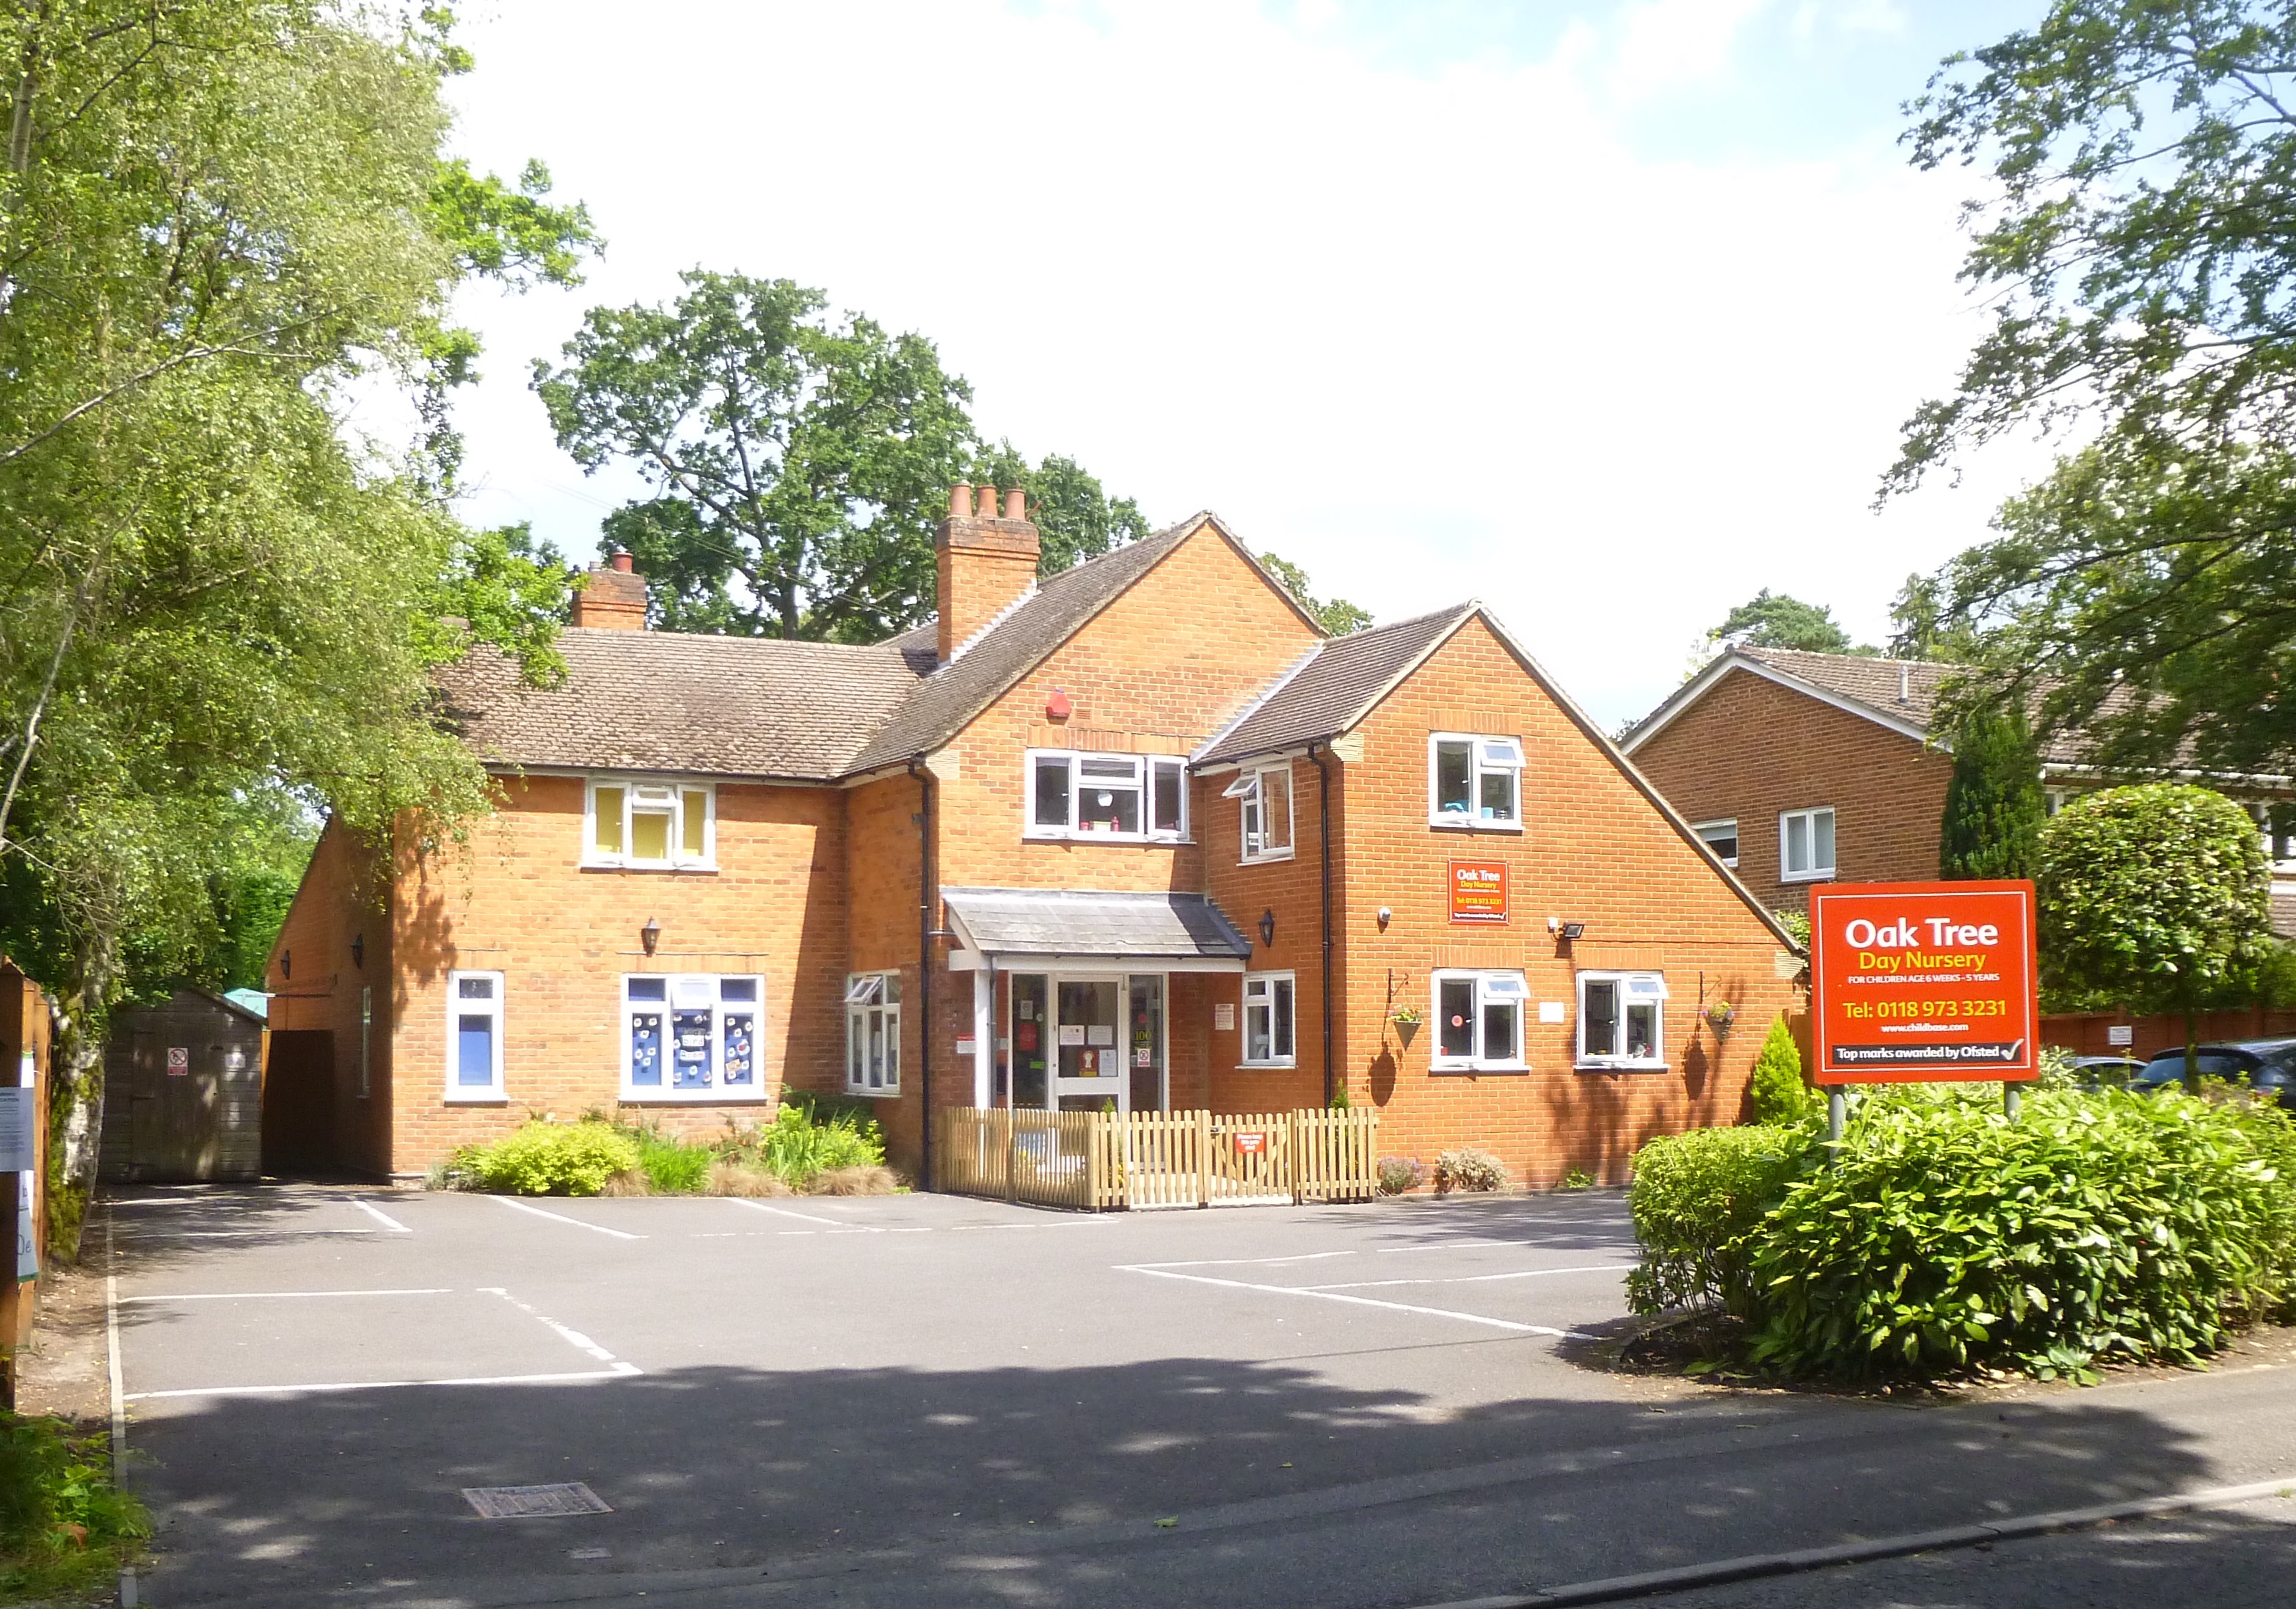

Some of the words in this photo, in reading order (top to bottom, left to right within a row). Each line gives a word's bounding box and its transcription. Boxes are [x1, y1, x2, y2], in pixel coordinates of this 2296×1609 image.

[1457, 869, 1479, 880] Oak
[1479, 870, 1500, 881] Tree
[1473, 881, 1496, 889] Nursery
[1845, 917, 1920, 948] Oak
[1925, 917, 1998, 946] Tree
[1859, 952, 1901, 973] Day
[1906, 951, 1986, 971] Nursery
[1866, 975, 1907, 983] CHILDREN
[1908, 974, 1925, 982] AGE
[1925, 974, 1931, 982] 6
[1932, 974, 1961, 982] WEEKS
[1973, 973, 2000, 981] YEARS
[1843, 1001, 1873, 1018] Tel:
[1877, 1001, 1919, 1017] 0118
[1923, 1001, 1958, 1017] 973
[1961, 1000, 2005, 1016] 3231
[1881, 1023, 1969, 1032] www.childbase.com
[1837, 1048, 1858, 1061] Top
[1859, 1047, 1894, 1058] marks
[1895, 1046, 1944, 1058] awarded
[1945, 1046, 1959, 1059] by
[1961, 1046, 2000, 1057] Ofsted
